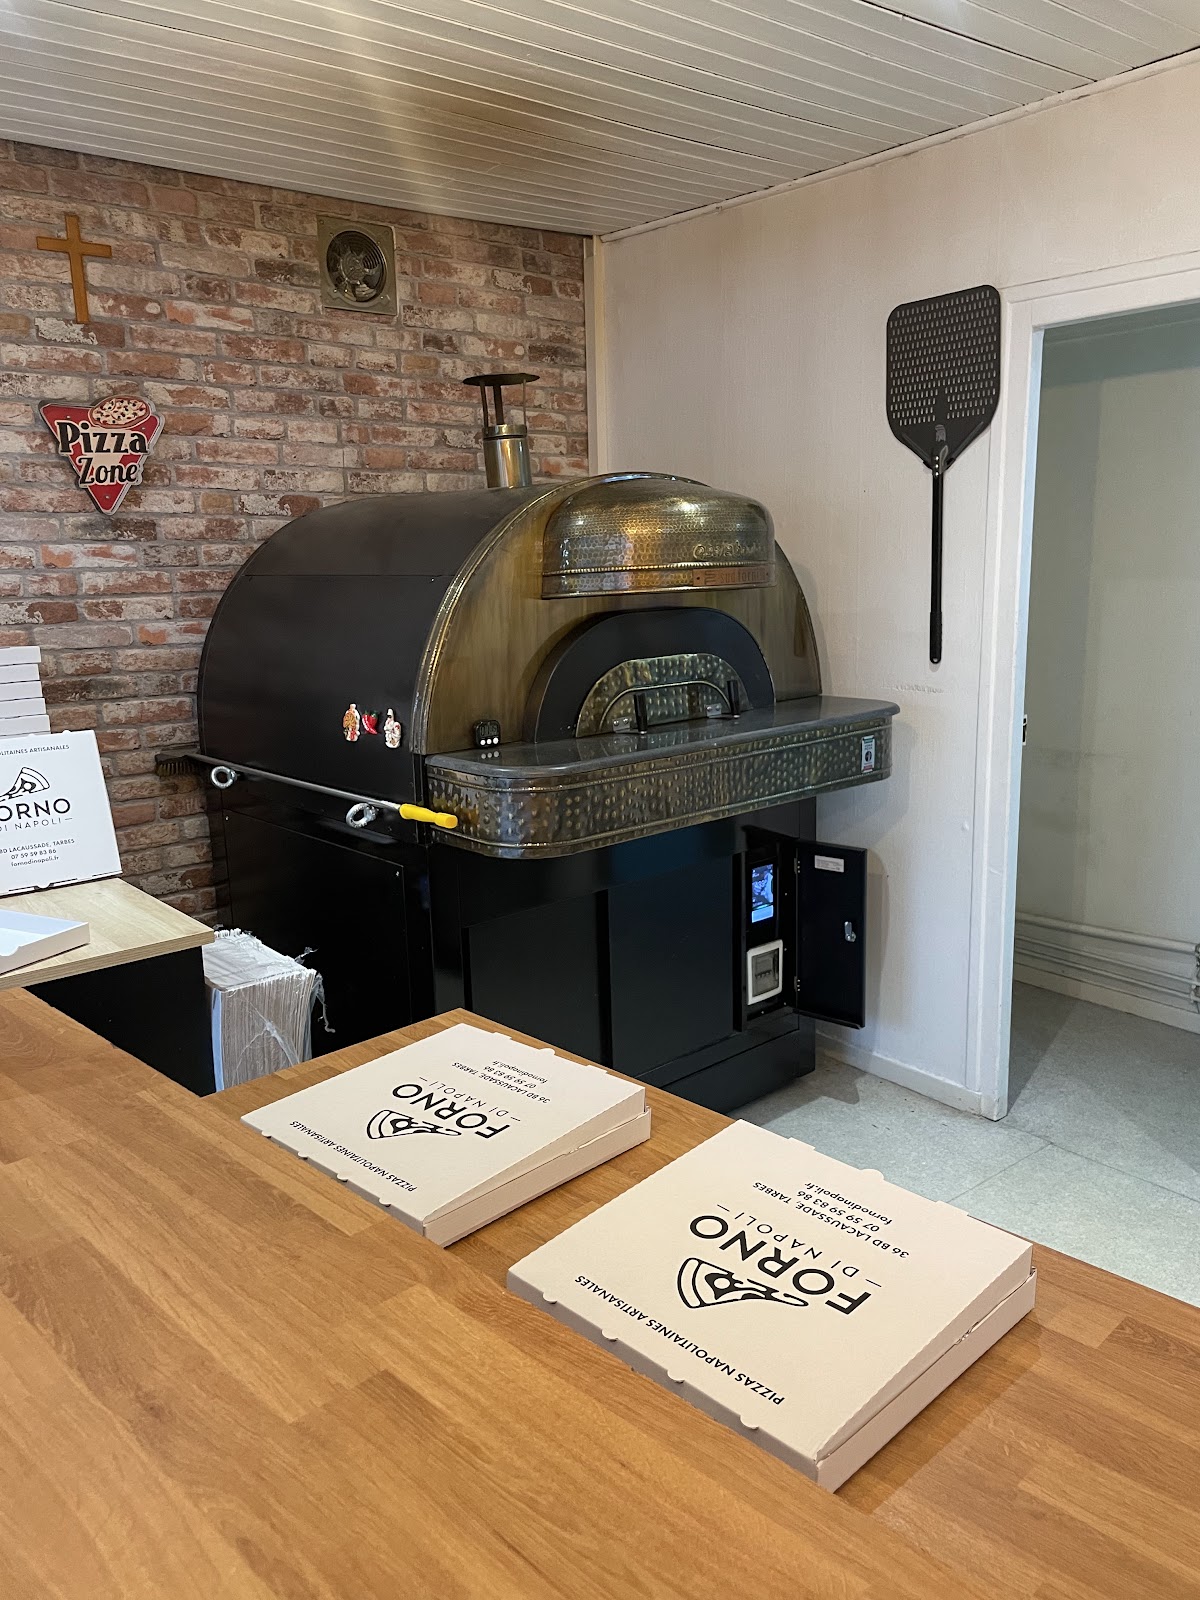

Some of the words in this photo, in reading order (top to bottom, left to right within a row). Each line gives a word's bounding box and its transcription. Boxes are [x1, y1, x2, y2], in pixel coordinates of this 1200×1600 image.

[57, 422, 148, 453] Pizza
[78, 458, 137, 484] Zone
[30, 745, 69, 753] ARTISANALES
[15, 818, 61, 830] NAPOLI
[9, 842, 51, 852] LACAUSSADE,
[11, 856, 59, 866] fornodinapoli.fr
[452, 1062, 478, 1075] TARBES
[492, 1061, 548, 1083] fornodinapoli.fr
[429, 1081, 486, 1107] NAPOLI
[392, 1084, 510, 1138] FORNO
[489, 1107, 509, 1117] DI
[290, 1121, 335, 1147] ARTISANALES
[333, 1145, 388, 1177] NAPOLITAINES
[386, 1174, 417, 1192] PIZZAS
[753, 1182, 792, 1204] TARBES
[796, 1191, 812, 1201] 86
[805, 1182, 893, 1225] fornodinapoli.fr
[813, 1199, 829, 1208] 83
[796, 1201, 871, 1241] LACAUSSADE,
[829, 1207, 846, 1216] 59
[846, 1215, 863, 1224] 59
[734, 1212, 822, 1259] NAPOLI
[862, 1223, 880, 1232] 07
[872, 1239, 891, 1250] BD
[892, 1247, 909, 1258] 36
[690, 1215, 871, 1315] FORNO
[831, 1260, 859, 1277] DI
[574, 1276, 648, 1320] ARTISANALES
[646, 1320, 736, 1375] NAPOLITAINES
[734, 1373, 785, 1405] PIZZAS
